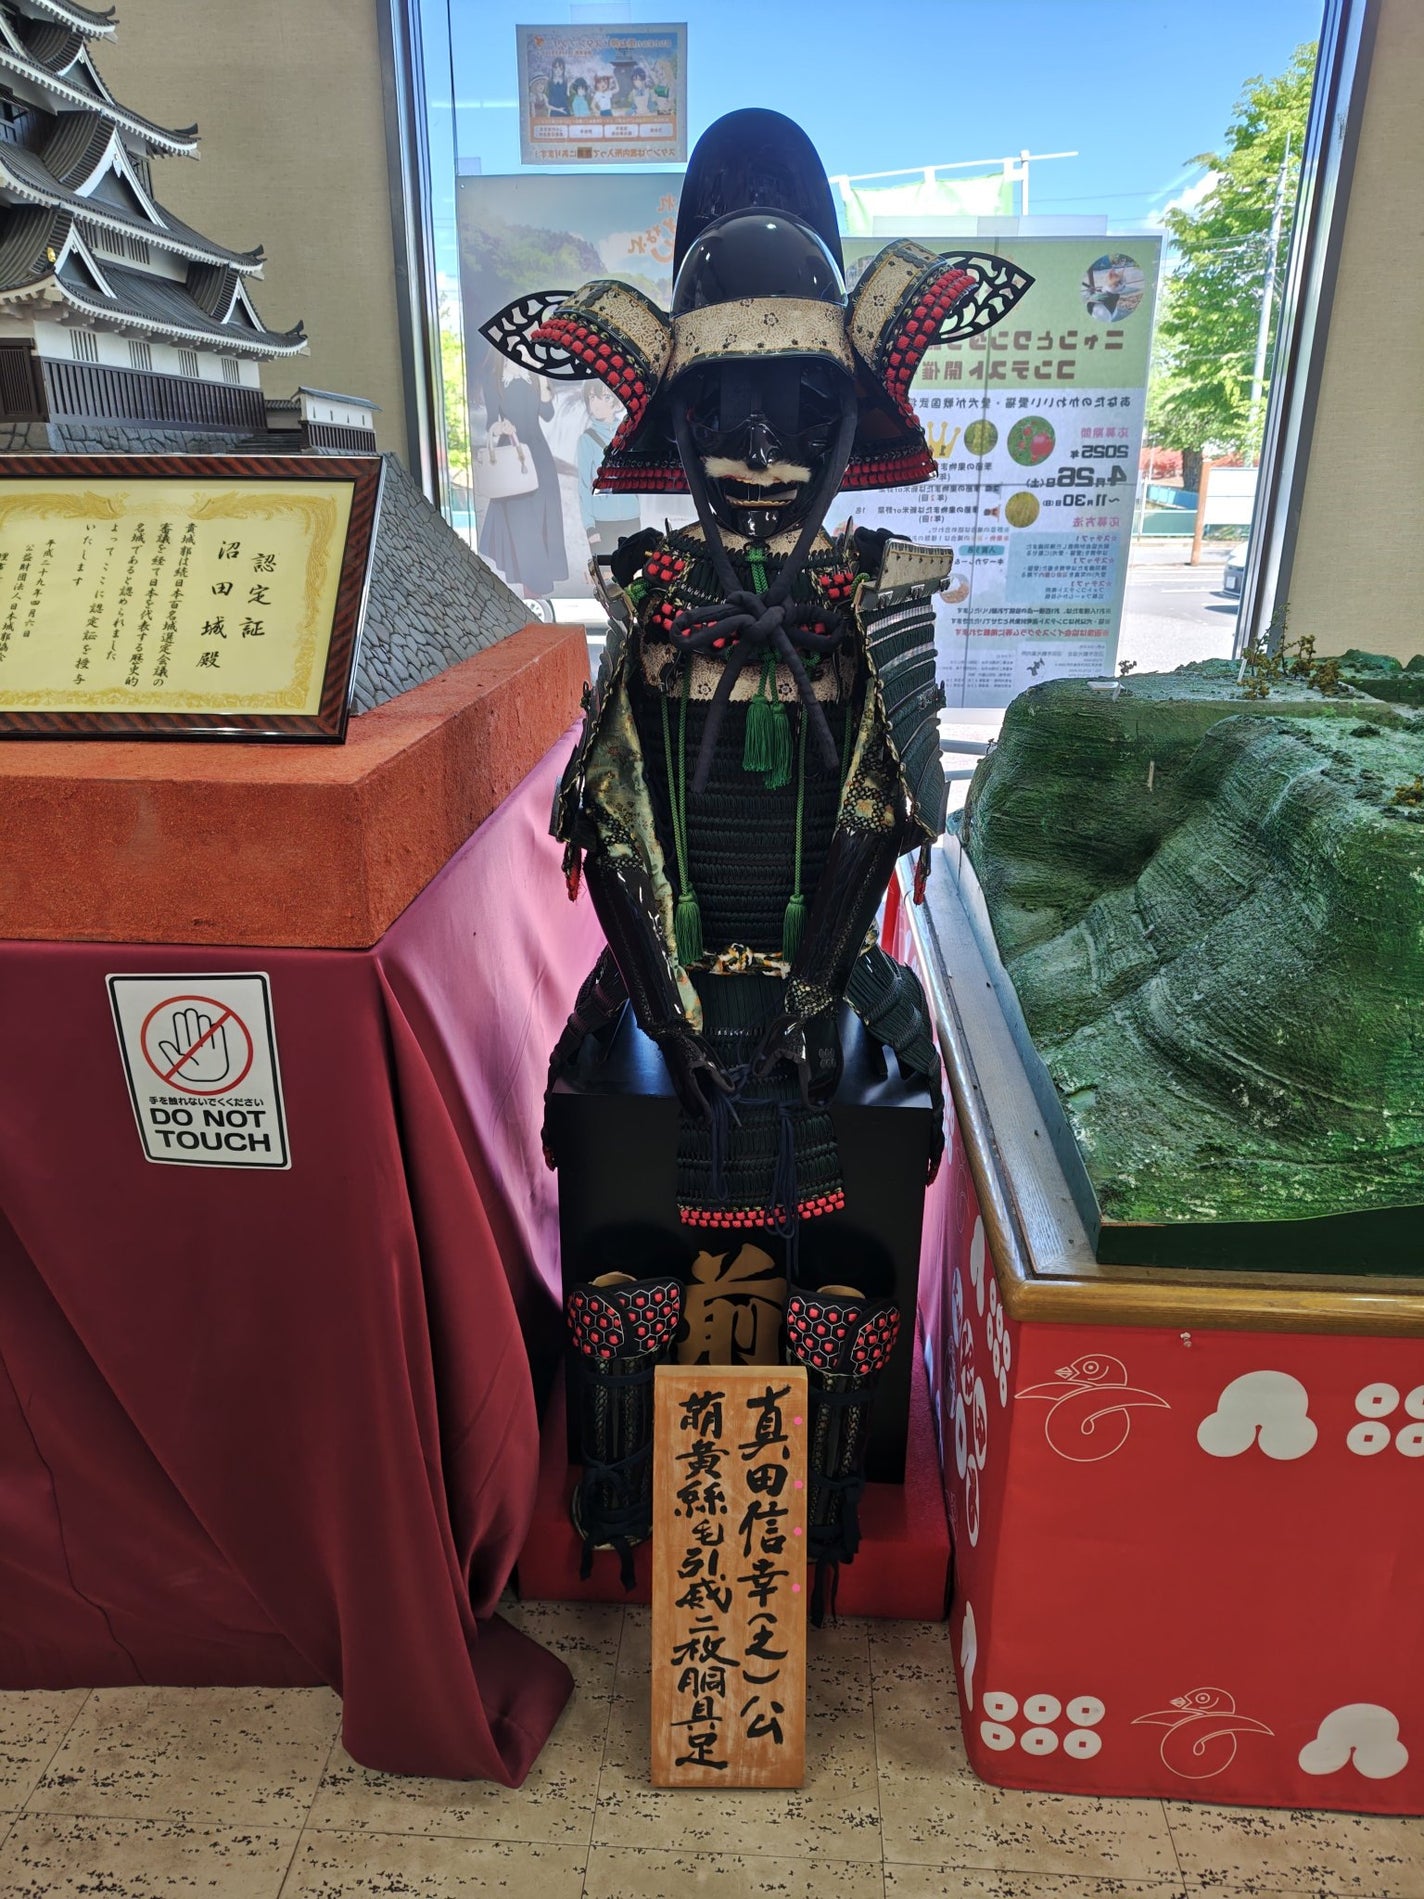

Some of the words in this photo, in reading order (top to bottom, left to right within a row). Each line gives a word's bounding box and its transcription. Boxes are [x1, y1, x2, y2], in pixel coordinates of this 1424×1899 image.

[72, 522, 97, 587] いたします
[239, 553, 277, 638] 認定証
[150, 1107, 194, 1127] DO
[204, 1109, 266, 1128] NOT
[154, 1129, 272, 1152] TOUCH
